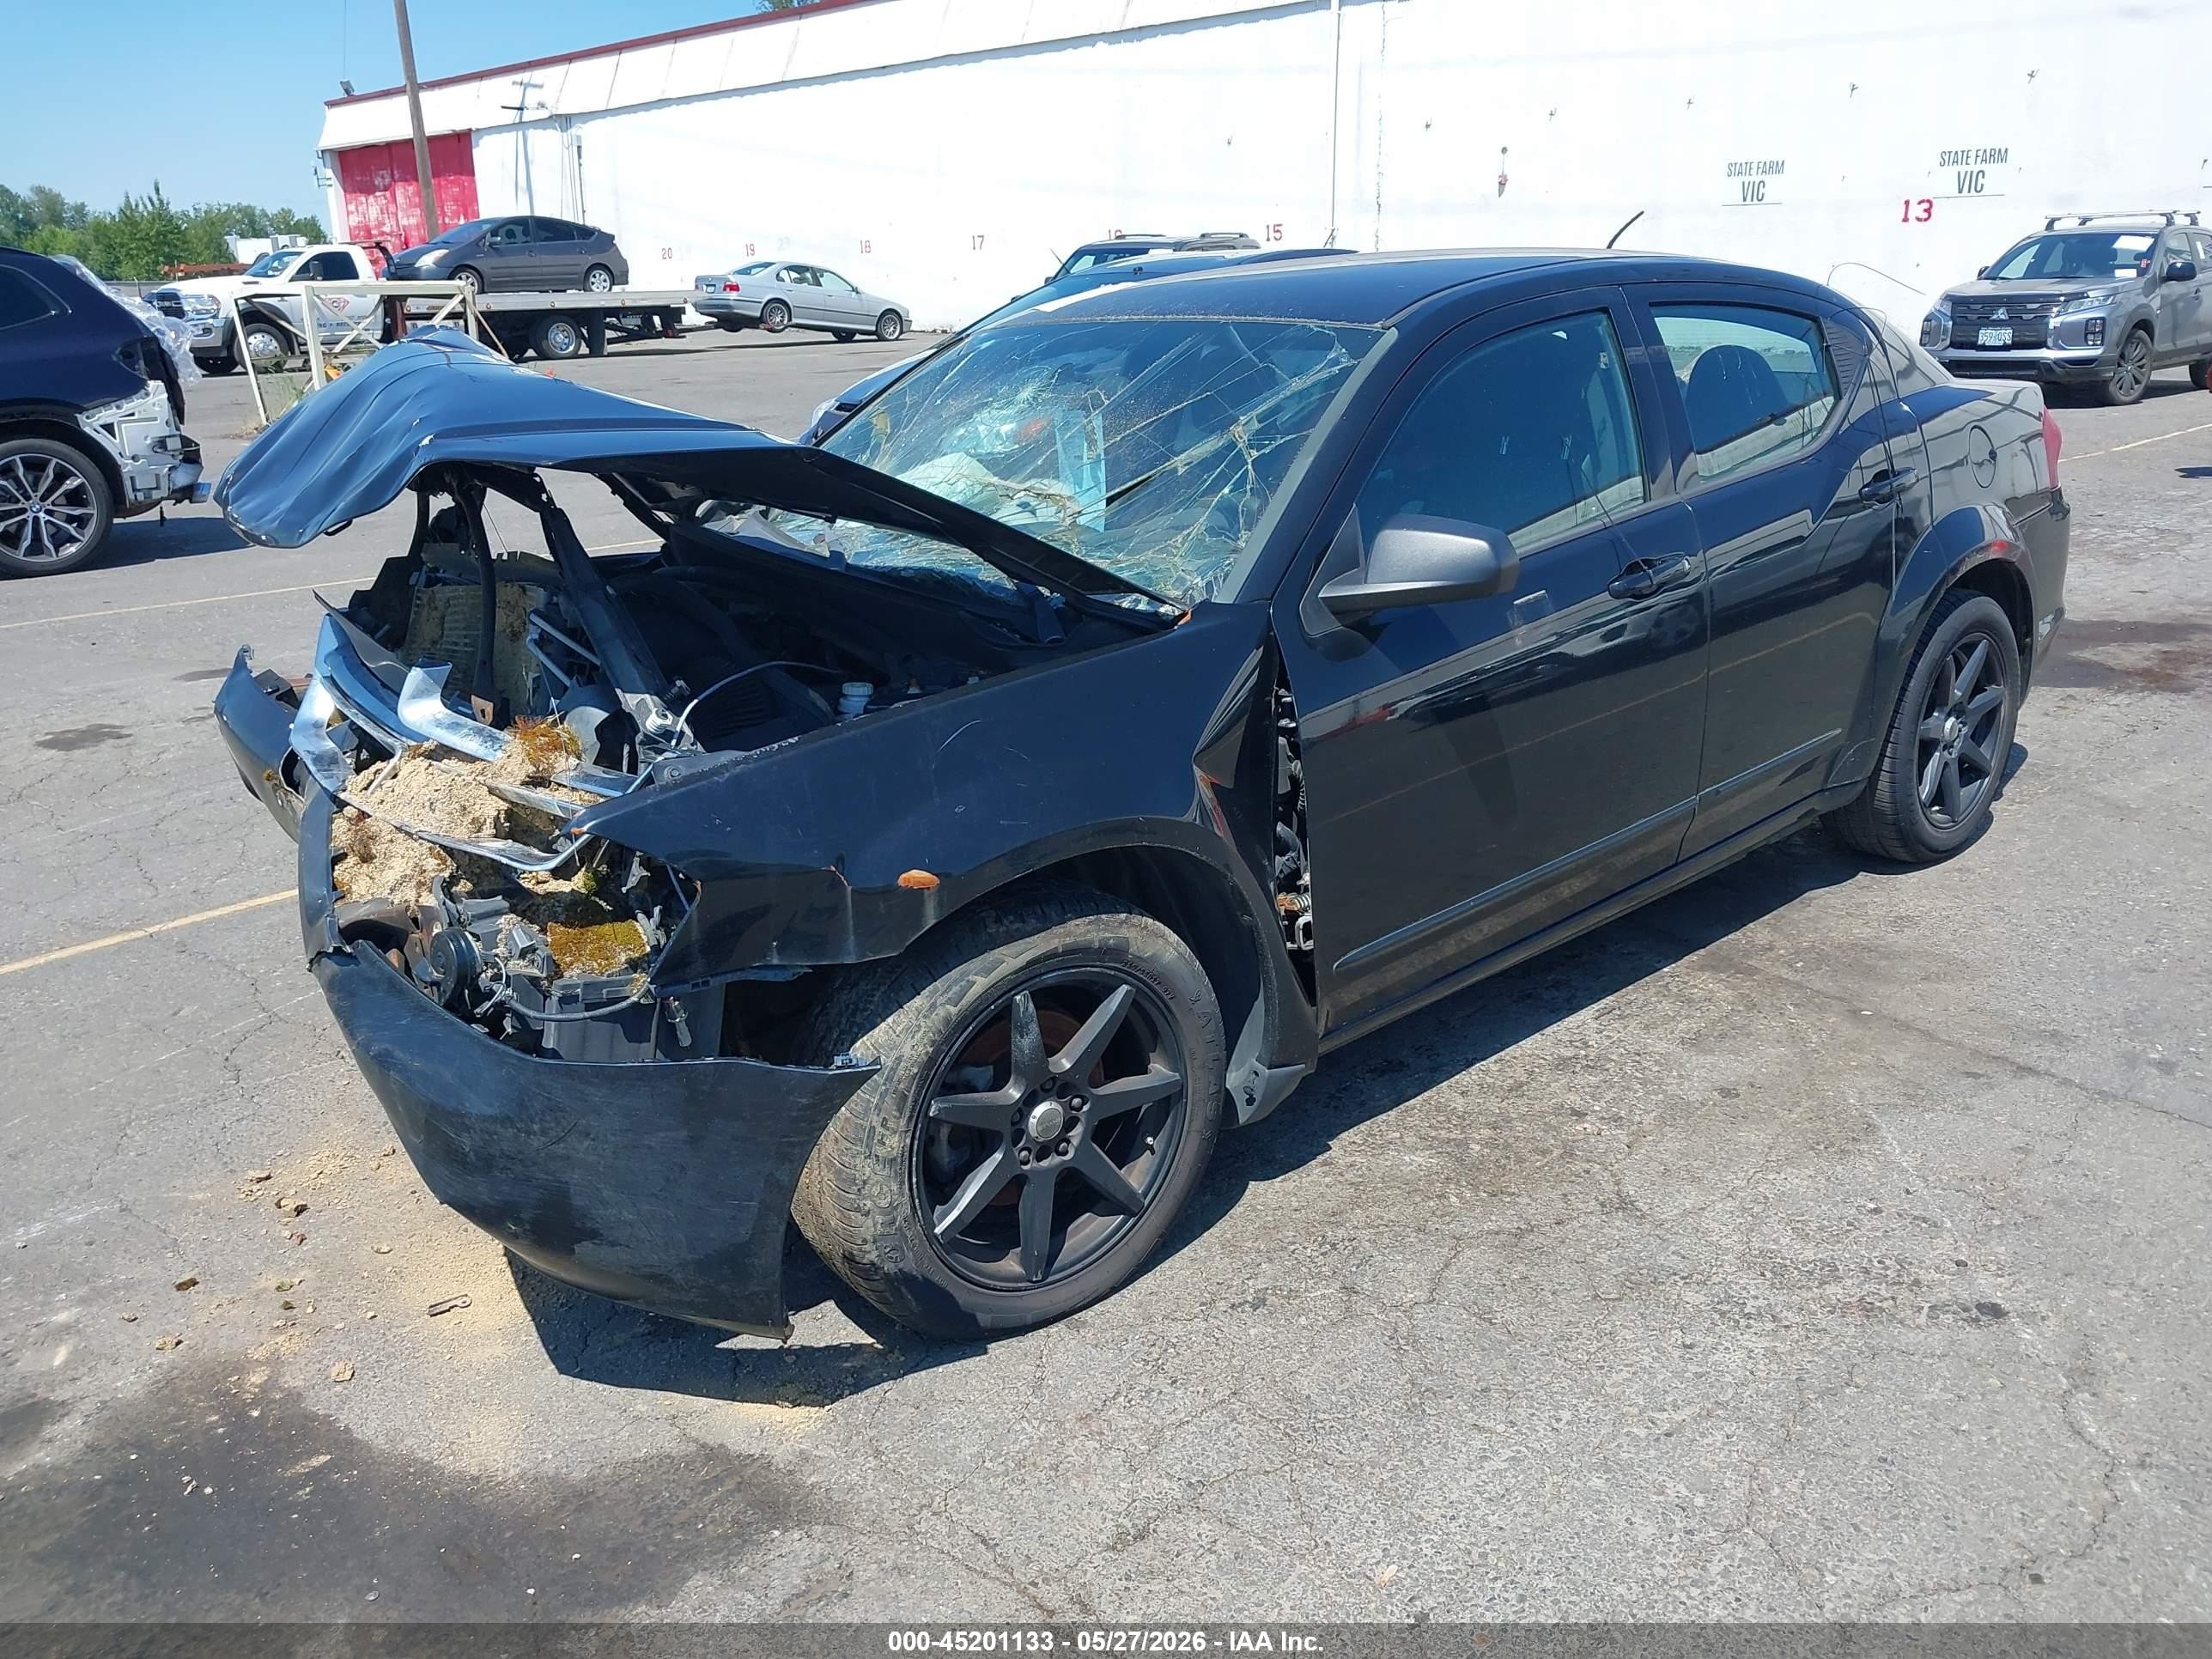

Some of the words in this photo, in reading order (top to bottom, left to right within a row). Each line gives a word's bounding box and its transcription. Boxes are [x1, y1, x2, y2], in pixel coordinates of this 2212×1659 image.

[1940, 150, 1972, 167] STATE
[1974, 147, 2008, 165] FARM
[1727, 161, 1753, 177] STATE
[1756, 160, 1785, 176] FARM
[1742, 179, 1765, 202] VIC
[1957, 170, 1985, 194] VIC
[1901, 199, 1934, 222] 13
[1266, 223, 1283, 242] 15
[745, 243, 756, 257] 19
[860, 240, 872, 254] 18
[972, 234, 985, 250] 17
[662, 247, 672, 259] 20
